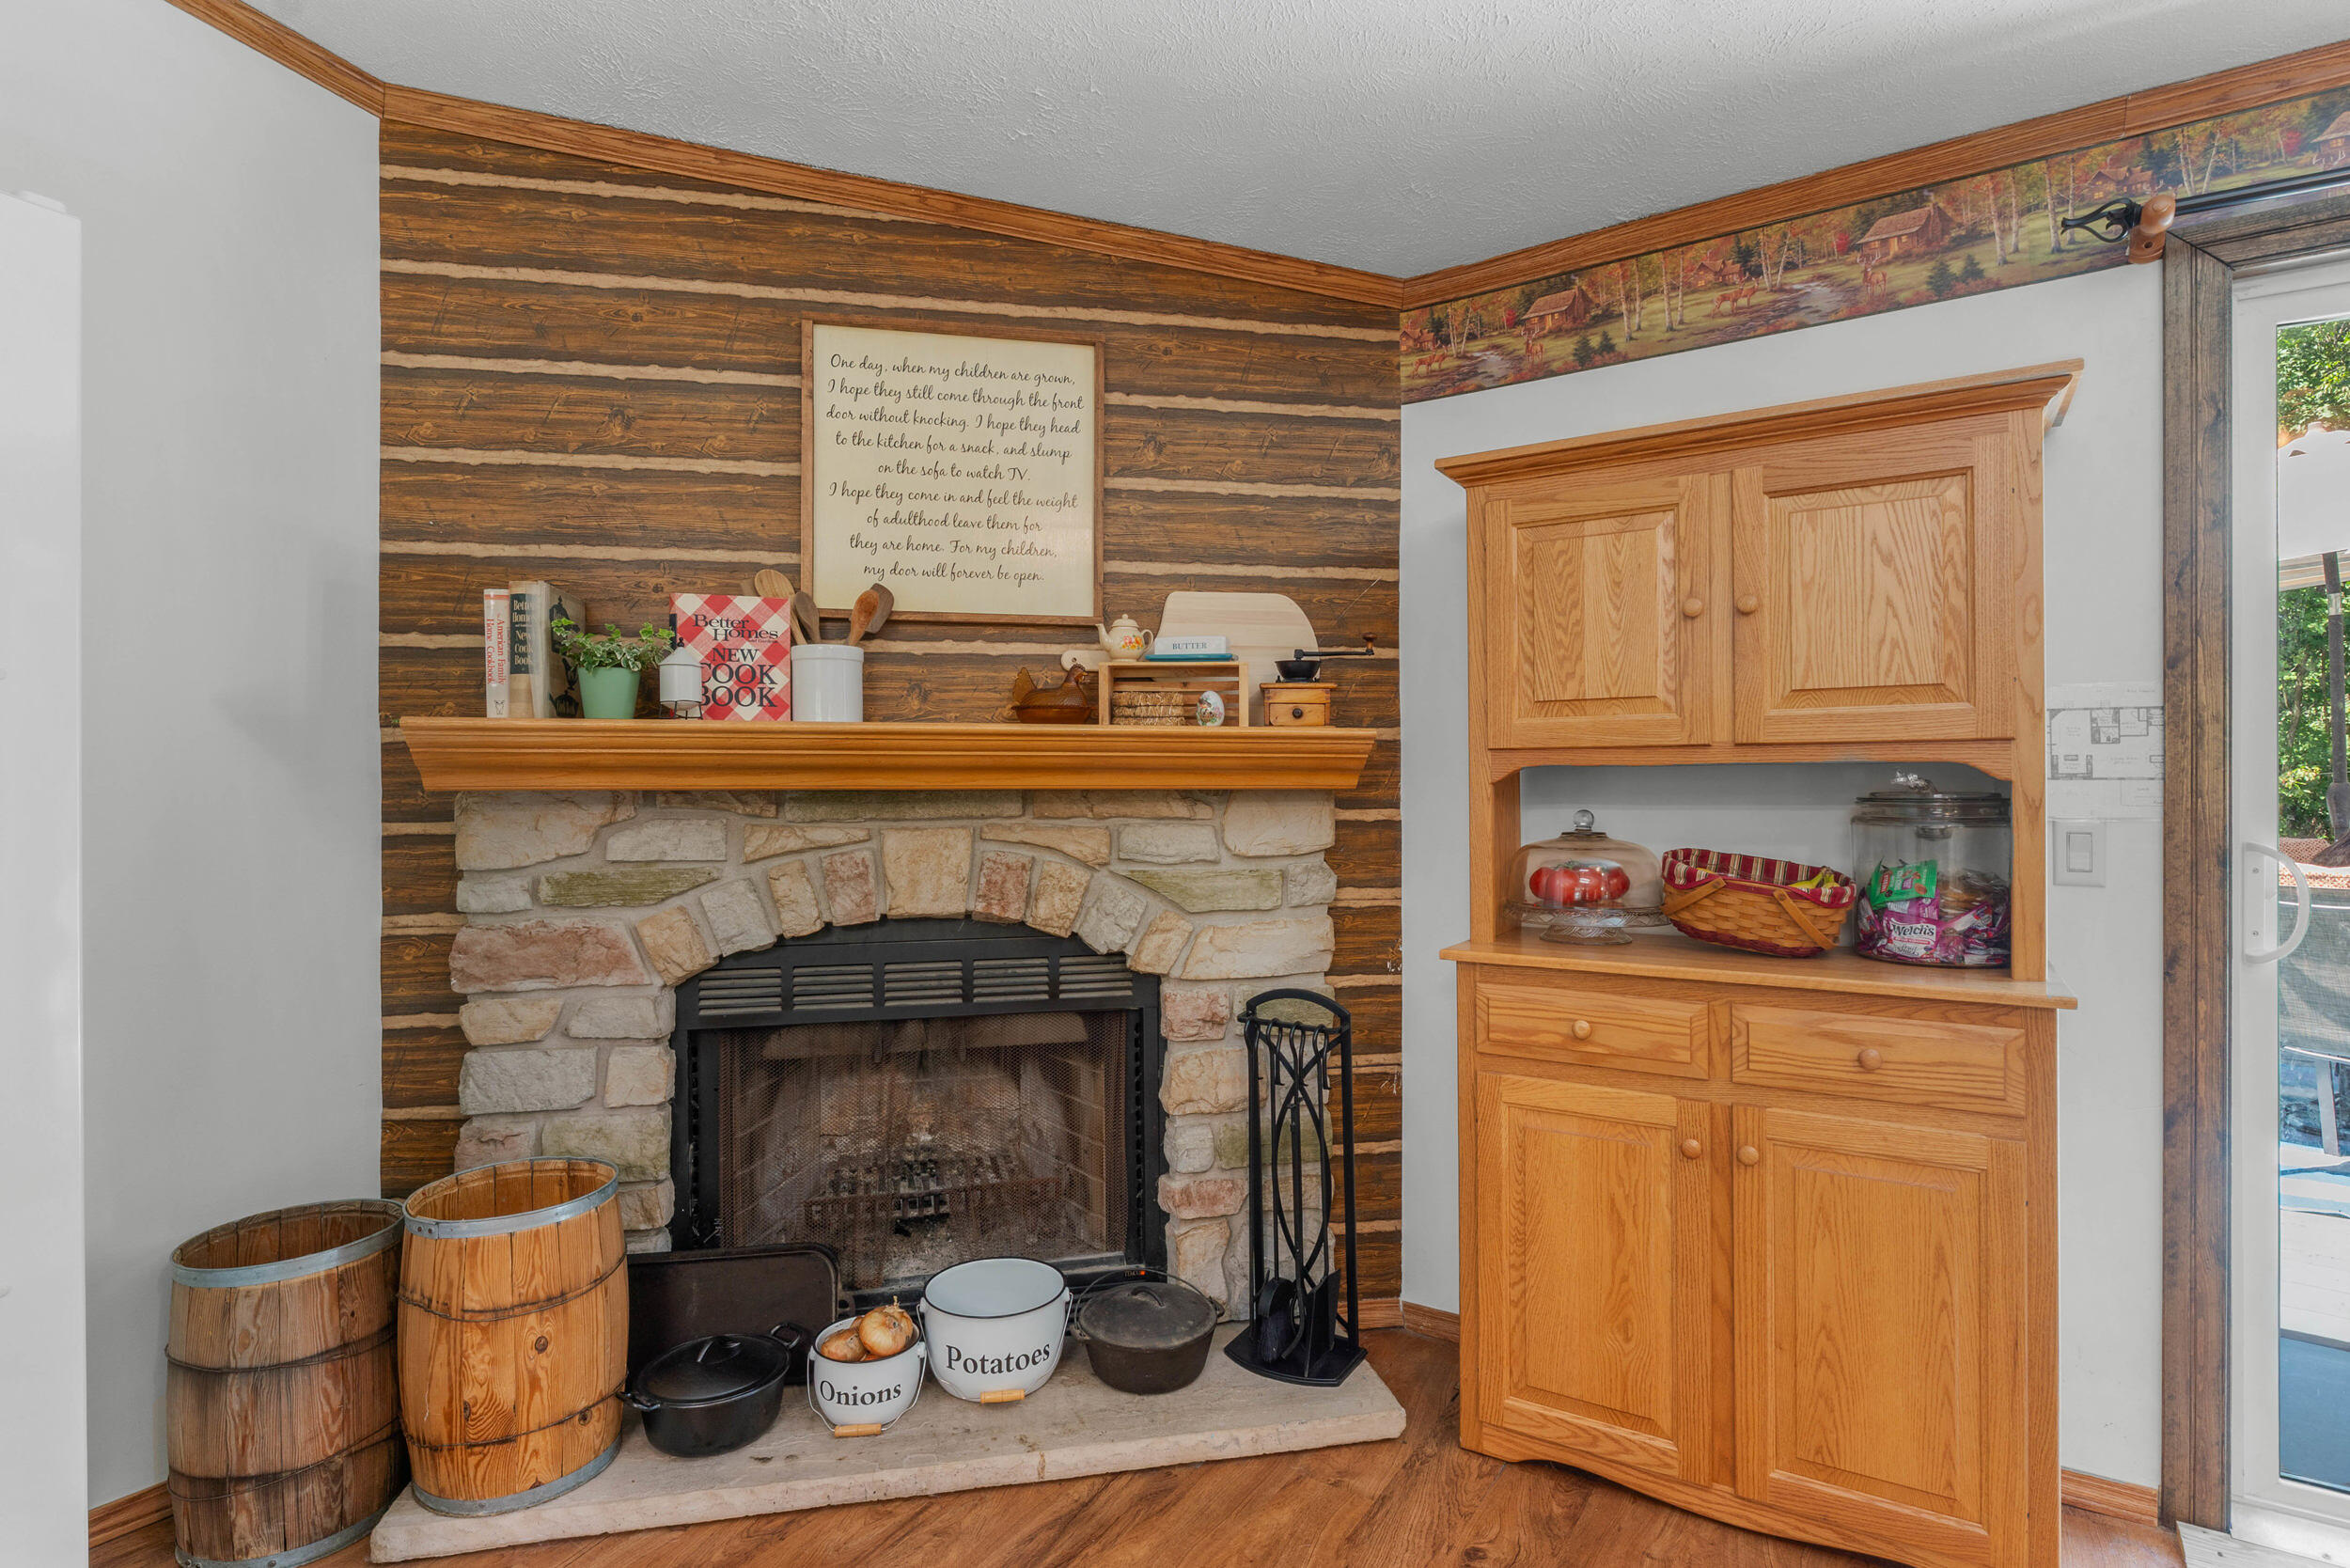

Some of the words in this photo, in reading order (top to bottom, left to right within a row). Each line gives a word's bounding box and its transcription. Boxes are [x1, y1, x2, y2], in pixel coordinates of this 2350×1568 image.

[831, 353, 857, 368] One
[892, 356, 927, 373] when
[929, 366, 949, 382] my
[955, 361, 1009, 382] children
[1011, 371, 1031, 382] are
[827, 379, 836, 393] I
[840, 378, 870, 402] hope
[872, 380, 901, 404] they
[904, 384, 934, 400] still
[937, 393, 970, 402] come
[973, 387, 1026, 411] through
[1028, 391, 1050, 407] the
[1052, 392, 1084, 412] front
[826, 403, 856, 420] door
[859, 406, 911, 424] without
[975, 415, 982, 428] I
[987, 414, 1016, 436] hope
[1020, 416, 1045, 438] they
[1050, 417, 1082, 434] head
[836, 431, 849, 445] to
[852, 429, 874, 447] the
[876, 432, 924, 451] kitchen
[927, 434, 948, 454] for
[1004, 442, 1029, 456] and
[1031, 442, 1072, 465] slump
[878, 464, 894, 474] on
[896, 459, 917, 474] the
[920, 461, 948, 480] sofa
[951, 463, 964, 478] to
[966, 463, 1005, 479] watch
[829, 482, 837, 496] I
[841, 480, 872, 505] hope
[875, 482, 902, 506] they
[908, 492, 941, 502] come
[944, 492, 957, 502] in
[960, 489, 985, 504] and
[986, 489, 1010, 510] feel
[1012, 492, 1033, 506] the
[1036, 493, 1078, 512] weight
[867, 508, 879, 527] of
[883, 510, 950, 526] adulthood
[953, 512, 984, 528] leave
[987, 514, 1020, 530] them
[1024, 516, 1042, 534] for
[850, 532, 877, 556] they
[881, 541, 902, 551] are
[950, 540, 973, 554] For
[976, 544, 998, 560] my
[864, 565, 885, 584] my
[889, 560, 919, 576] door
[922, 562, 948, 578] will
[950, 562, 995, 582] forever
[997, 564, 1011, 579] be
[692, 614, 750, 629] Better
[713, 628, 778, 641] Homes
[497, 619, 506, 656] American
[514, 643, 533, 653] Cook
[486, 646, 495, 684] Cookbook
[514, 654, 533, 666] Book
[712, 648, 759, 662] NEW
[497, 659, 507, 685] Family
[1892, 923, 1935, 936] Welch's
[946, 1343, 1051, 1374] Potatoes
[820, 1380, 901, 1406] Onions
